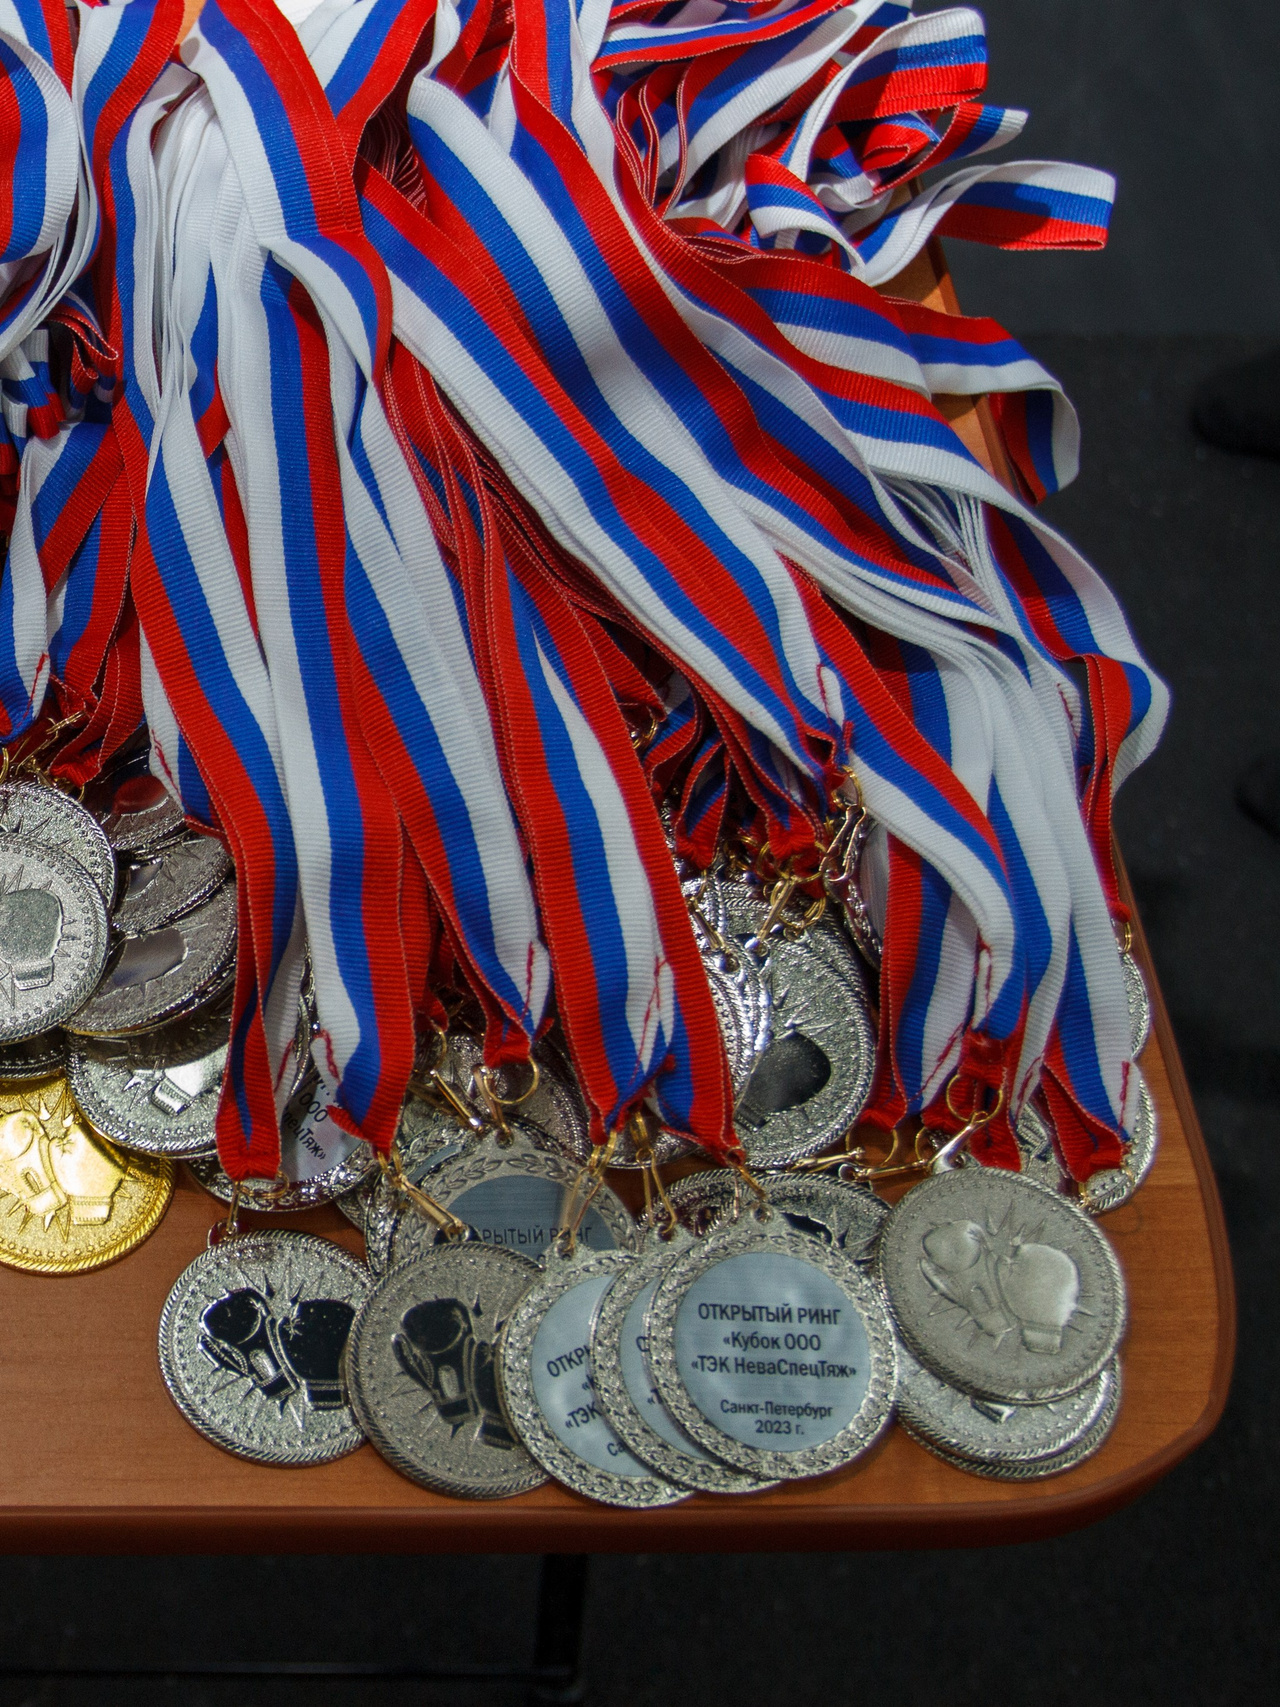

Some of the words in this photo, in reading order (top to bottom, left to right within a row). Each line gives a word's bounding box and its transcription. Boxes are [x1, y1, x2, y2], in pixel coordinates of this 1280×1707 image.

[480, 1224, 545, 1245] РЫТЫЙ
[549, 1226, 593, 1244] РНГ
[697, 1302, 793, 1323] ОТКРЫТЫЙ
[797, 1307, 842, 1325] РИНГ
[722, 1331, 781, 1352] «Кубок
[784, 1332, 822, 1351] ООО
[691, 1355, 730, 1374] «ТЭК
[733, 1356, 858, 1380] НеваСпецТяж»
[719, 1399, 834, 1420] Санкт-Петербург
[754, 1419, 793, 1436] 2023
[795, 1423, 805, 1436] г.
